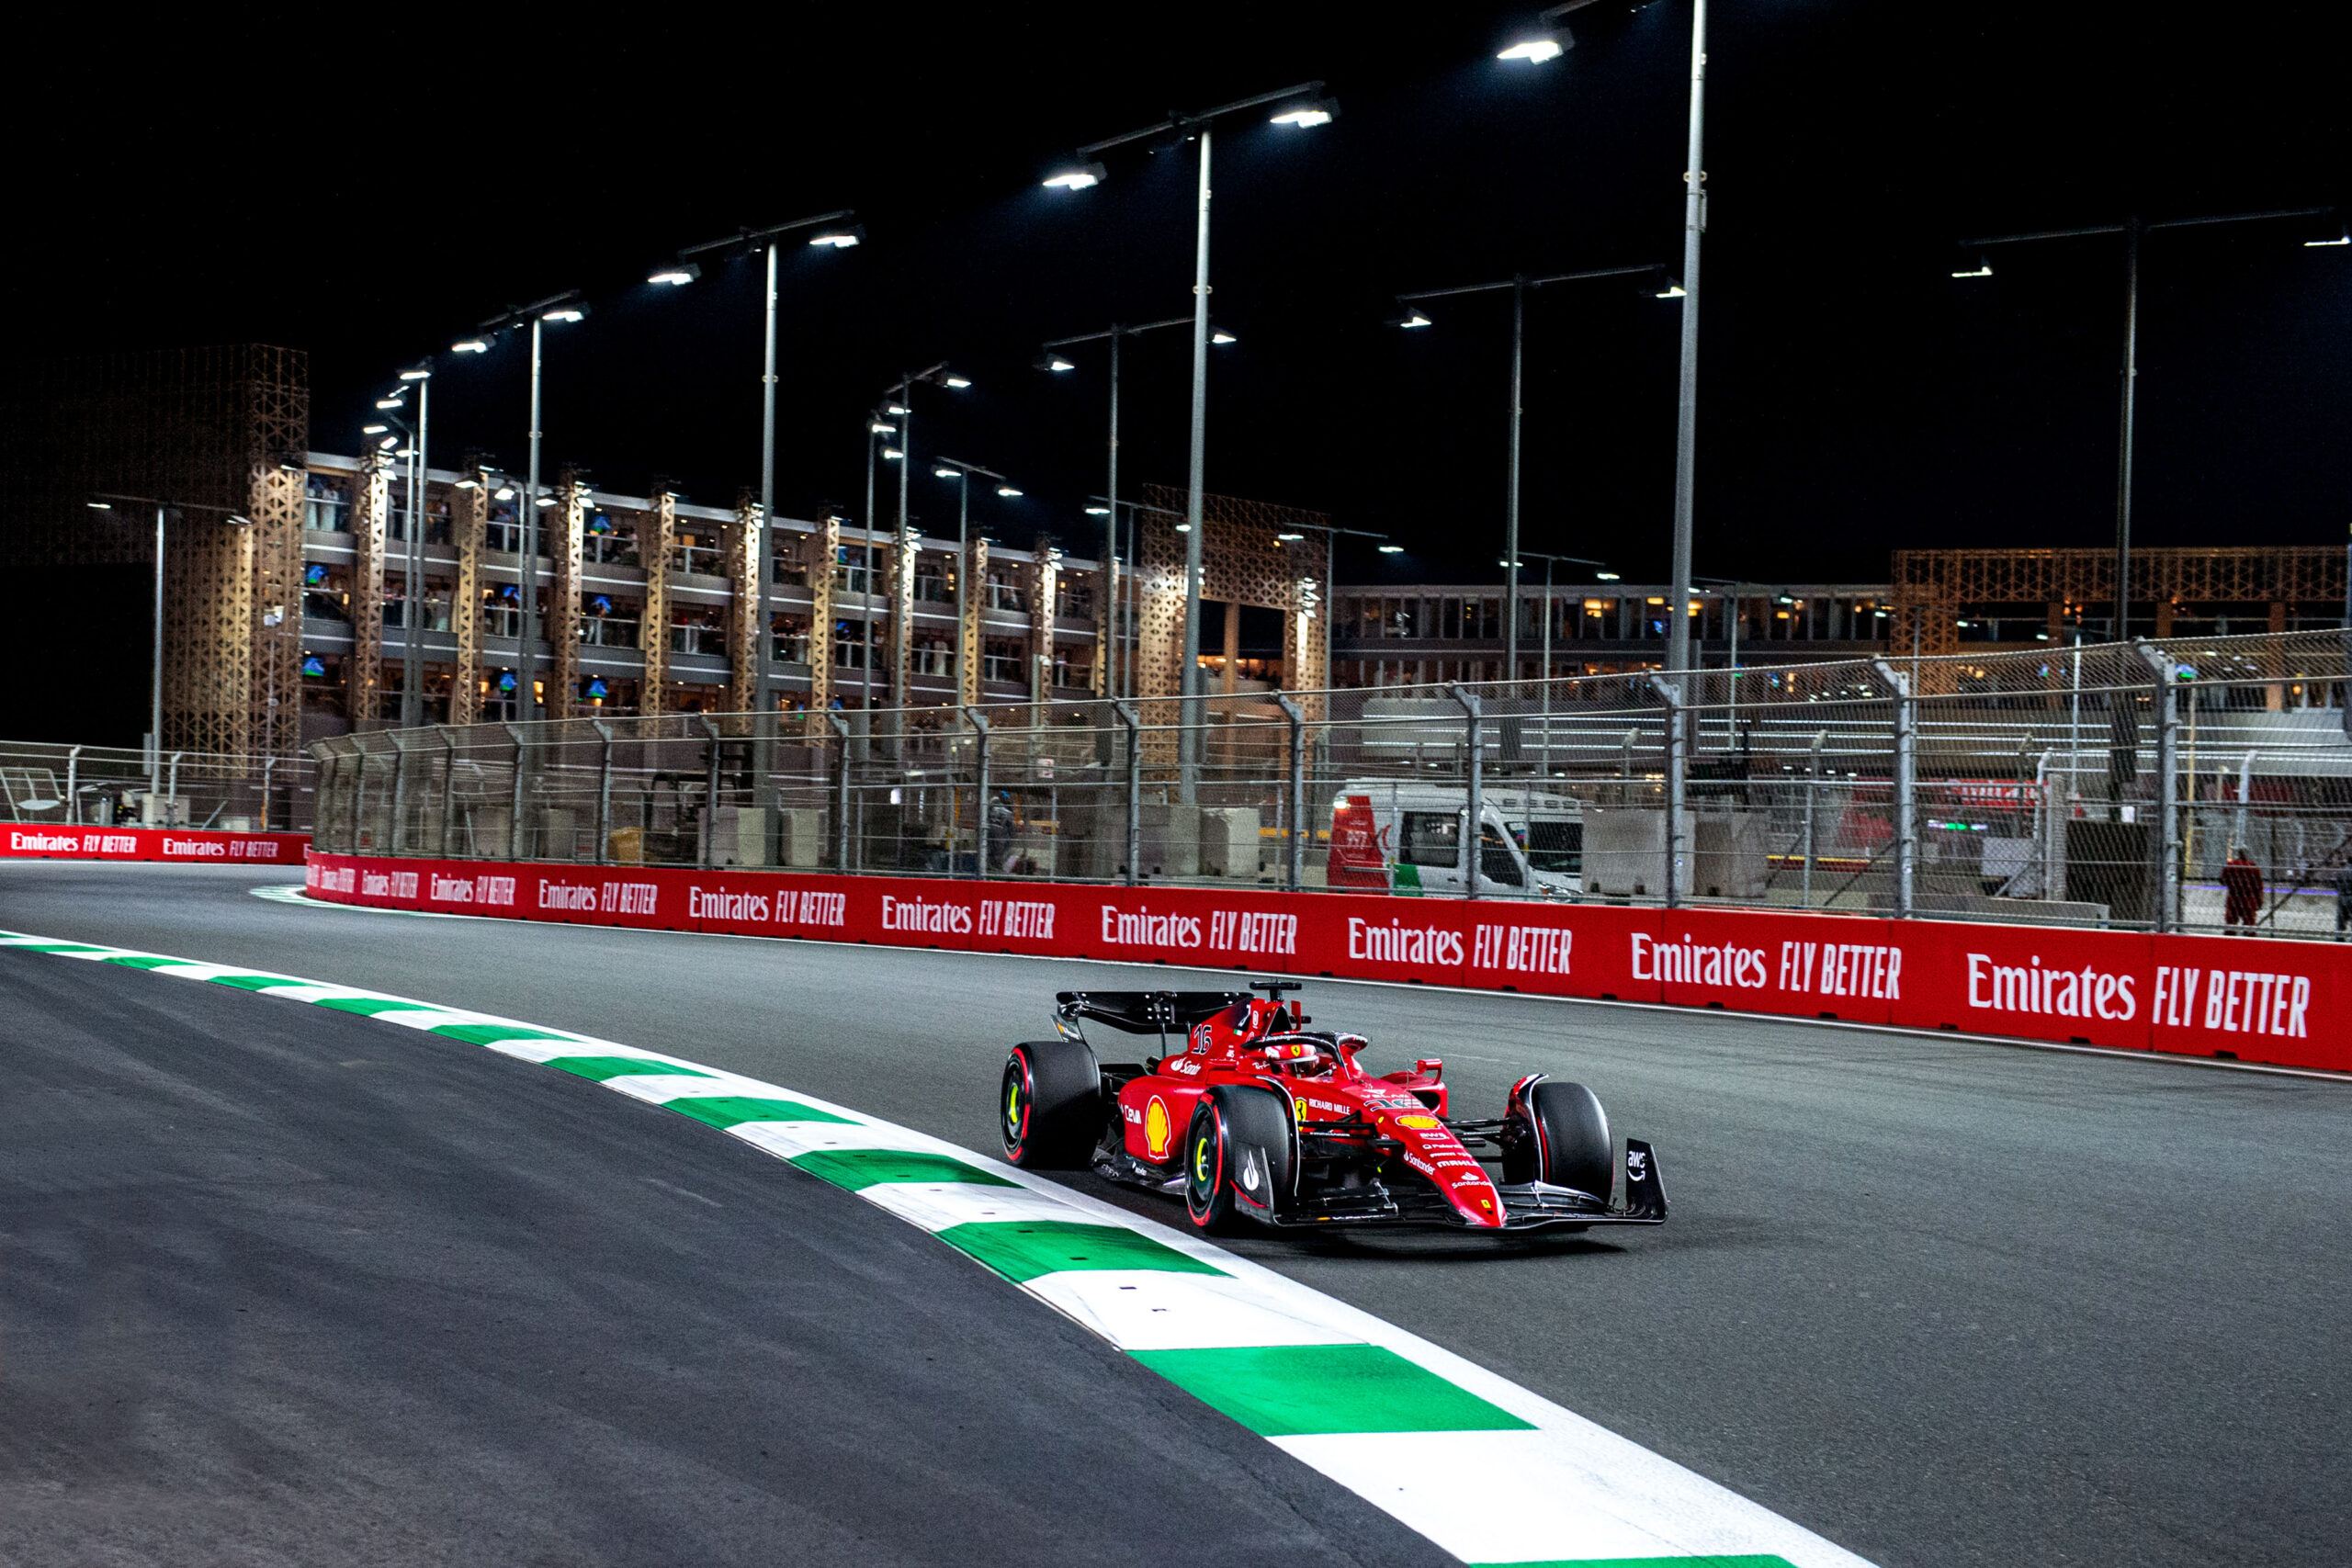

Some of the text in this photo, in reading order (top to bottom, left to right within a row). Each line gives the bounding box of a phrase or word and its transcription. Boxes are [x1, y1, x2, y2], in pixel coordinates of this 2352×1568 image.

[11, 832, 137, 853] Emirates FLY BETTER
[163, 838, 278, 857] Emirates FLY BETTER
[430, 874, 473, 902] Emirates
[538, 879, 658, 915] Emirates FLY BETTER
[690, 886, 845, 926] Emirates FLY BETTER
[882, 896, 1055, 940] Emirates FLY BETTER
[1102, 906, 1297, 954] Emirates FLY BETTER
[1348, 918, 1572, 974] Emirates FLY BETTER
[1631, 933, 1902, 1000] Emirates FLY BETTER
[1967, 953, 2310, 1038] Emirates FLY BETTER
[1192, 1023, 1212, 1055] 16
[1308, 1098, 1351, 1115] RICHARD MILLE
[1627, 1150, 1645, 1168] aws
